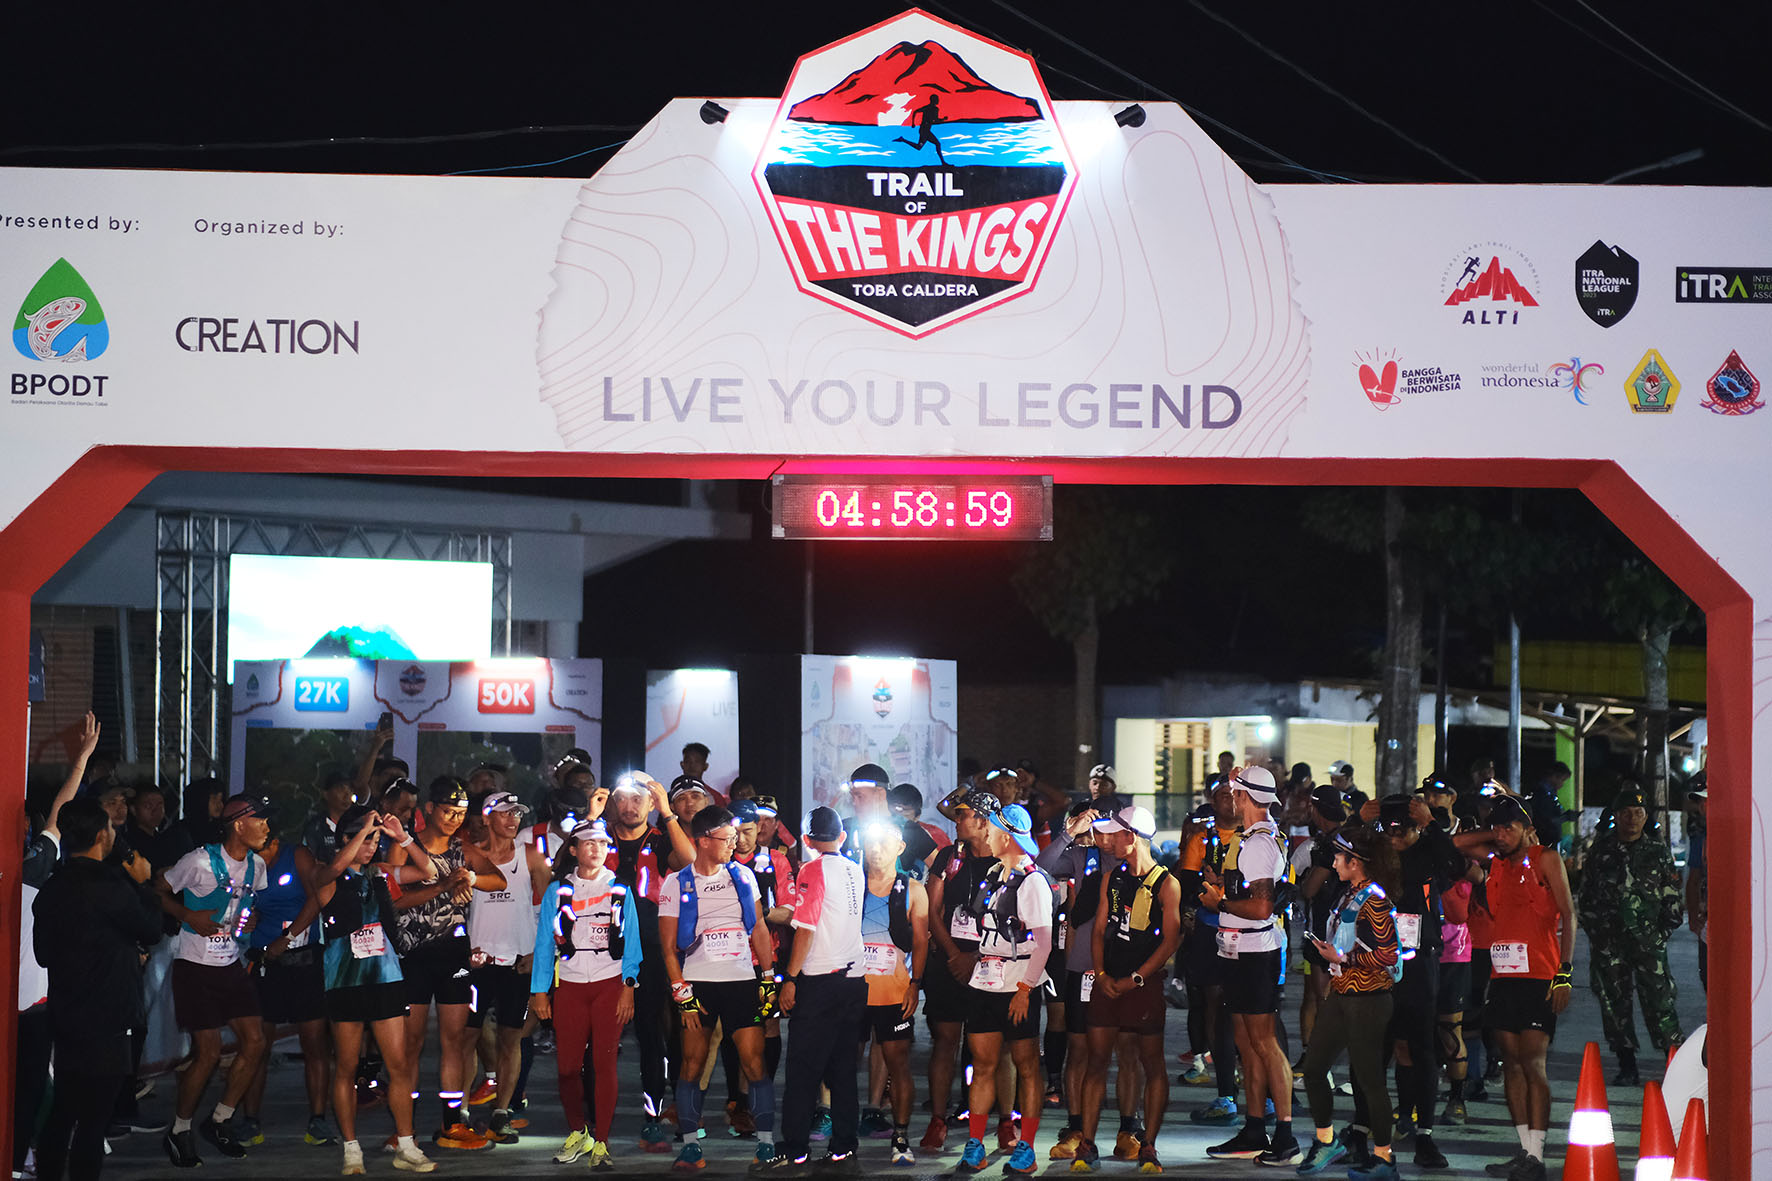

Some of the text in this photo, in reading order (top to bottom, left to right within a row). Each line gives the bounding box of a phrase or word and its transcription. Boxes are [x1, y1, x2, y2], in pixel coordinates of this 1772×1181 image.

[867, 173, 964, 196] TRAIL
[905, 202, 927, 214] OF
[0, 214, 139, 233] resented by:
[194, 218, 344, 238] Organized by:
[779, 201, 1048, 274] THE KINGS
[1582, 269, 1605, 277] ITRA
[1752, 275, 1772, 283] INTE
[1582, 277, 1632, 285] NATIONAL
[852, 283, 979, 297] TOBA CALDERA
[1582, 285, 1621, 293] LEAGUE
[1462, 310, 1519, 325] ALTI
[175, 317, 360, 355] CREATION
[1401, 367, 1442, 378] BANGGA
[1481, 363, 1539, 373] wonderful
[11, 373, 109, 397] BPODT
[1407, 373, 1461, 386] BERWISATA
[1481, 373, 1560, 388] indonesia
[1407, 382, 1461, 394] INDONESIA
[602, 376, 1243, 430] LIVE YOUR LEGEND
[816, 490, 1013, 527] 04:58:59
[298, 681, 342, 705] 27K
[481, 682, 530, 706] 50K
[353, 928, 375, 938] TOTK
[591, 926, 608, 934] TOT
[705, 932, 729, 940] TOTK
[894, 1021, 911, 1032] HOKA
